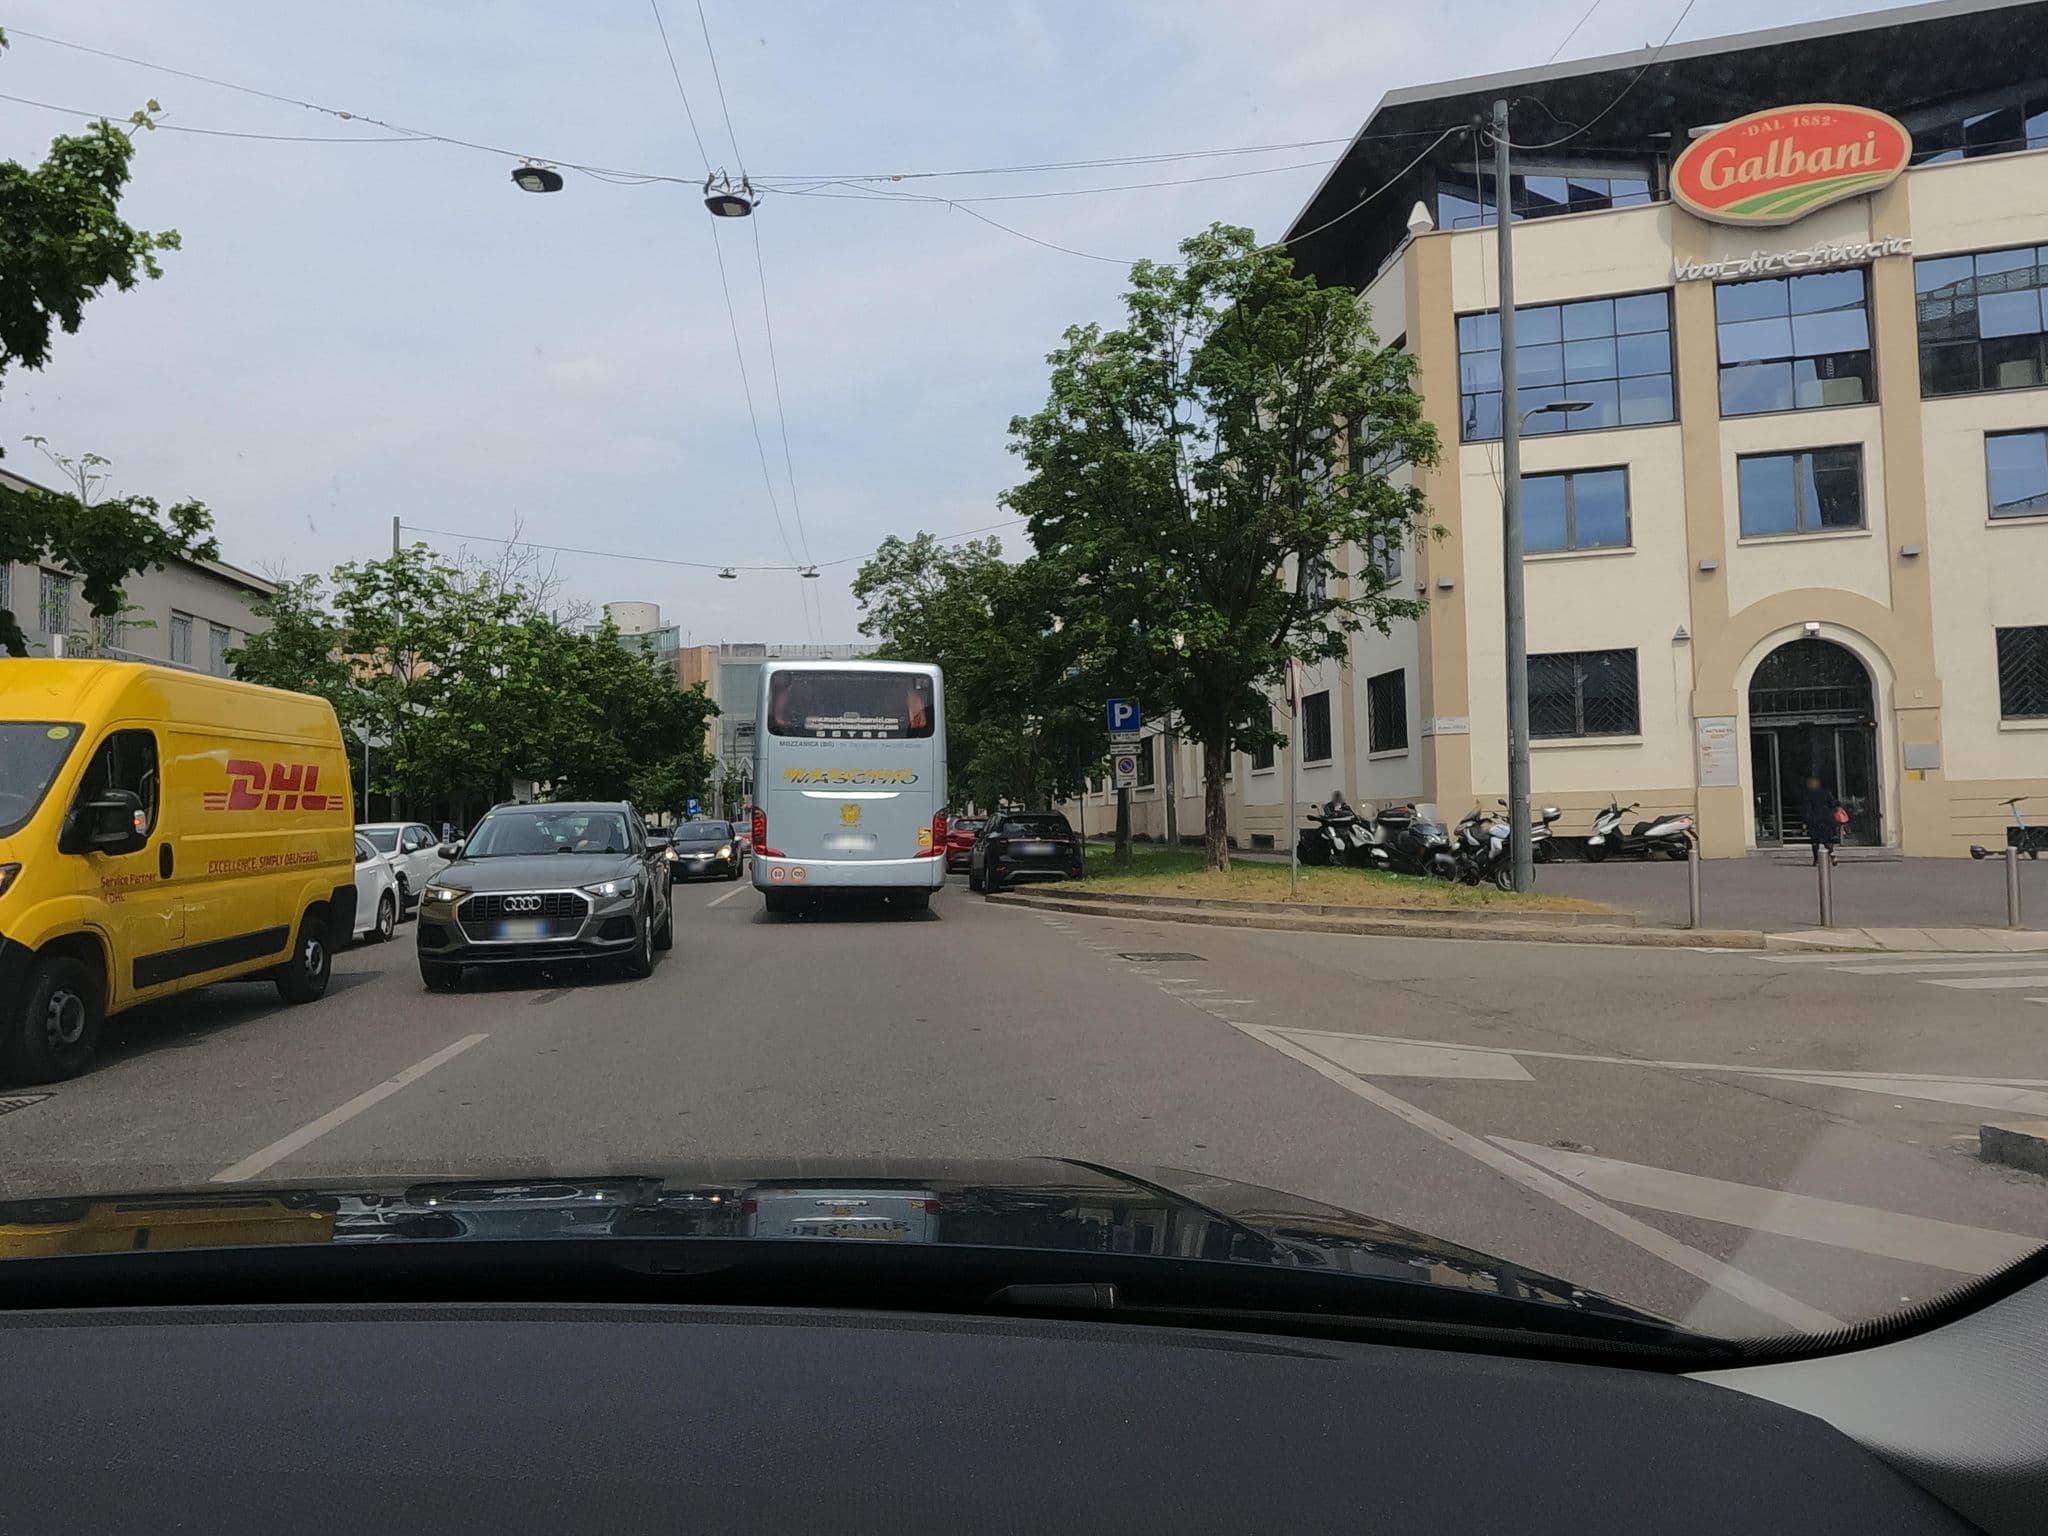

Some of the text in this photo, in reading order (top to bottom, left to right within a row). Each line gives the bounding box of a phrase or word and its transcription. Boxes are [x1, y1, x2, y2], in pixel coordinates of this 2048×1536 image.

[1700, 130, 1880, 191] Galbani
[1114, 703, 1133, 728] P
[226, 759, 328, 811] DHL
[101, 874, 129, 889] Service
